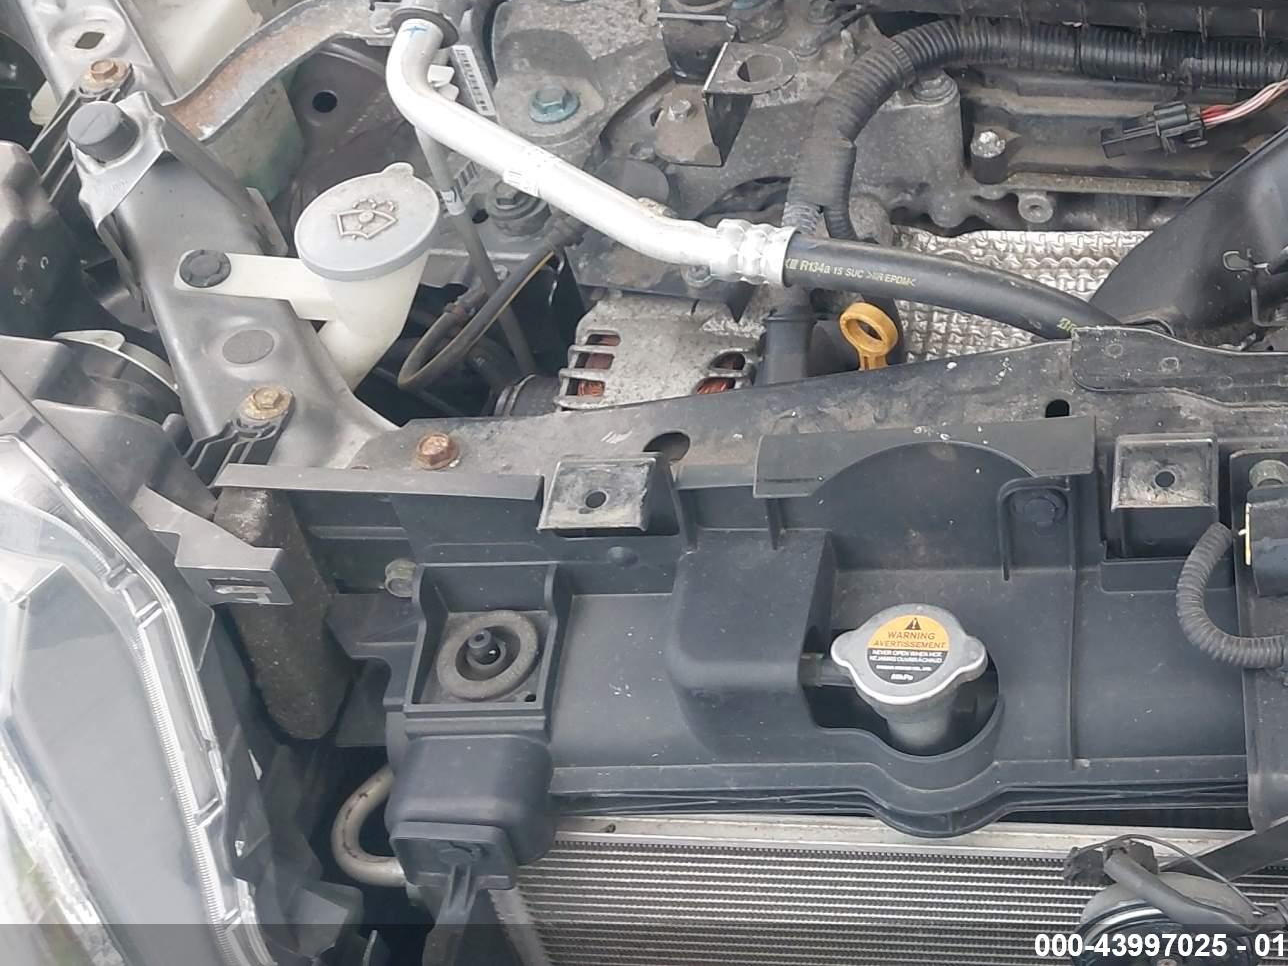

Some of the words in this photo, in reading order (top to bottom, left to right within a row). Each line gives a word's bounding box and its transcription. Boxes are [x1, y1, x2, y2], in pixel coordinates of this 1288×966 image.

[800, 260, 831, 274] R134a
[845, 267, 865, 279] SUC
[888, 631, 936, 640] WARNING
[872, 640, 946, 649] AVERTISSEMENT
